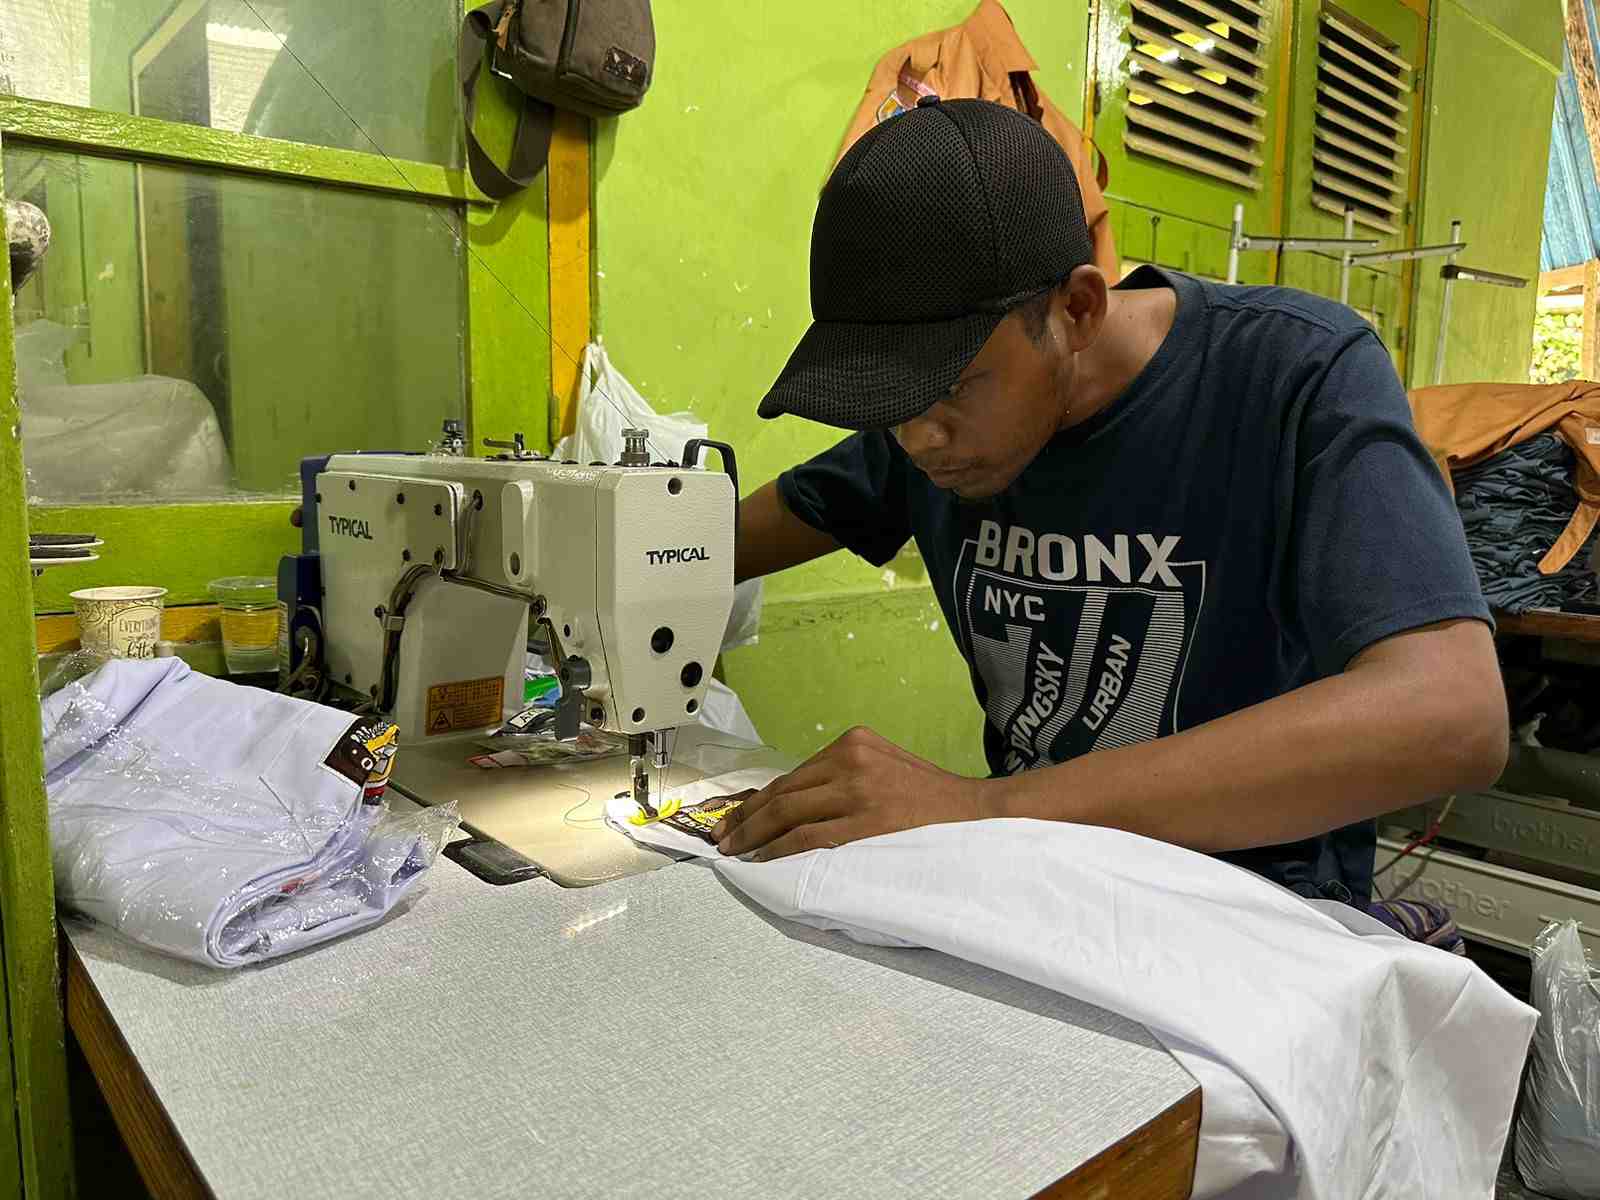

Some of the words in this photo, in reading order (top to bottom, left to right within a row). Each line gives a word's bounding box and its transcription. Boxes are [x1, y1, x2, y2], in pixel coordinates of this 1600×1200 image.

[328, 515, 373, 540] TYPICAL
[646, 547, 710, 565] TYPICAL
[975, 519, 1183, 587] BRONX
[984, 585, 1046, 621] NYC
[1082, 634, 1132, 730] URBAN
